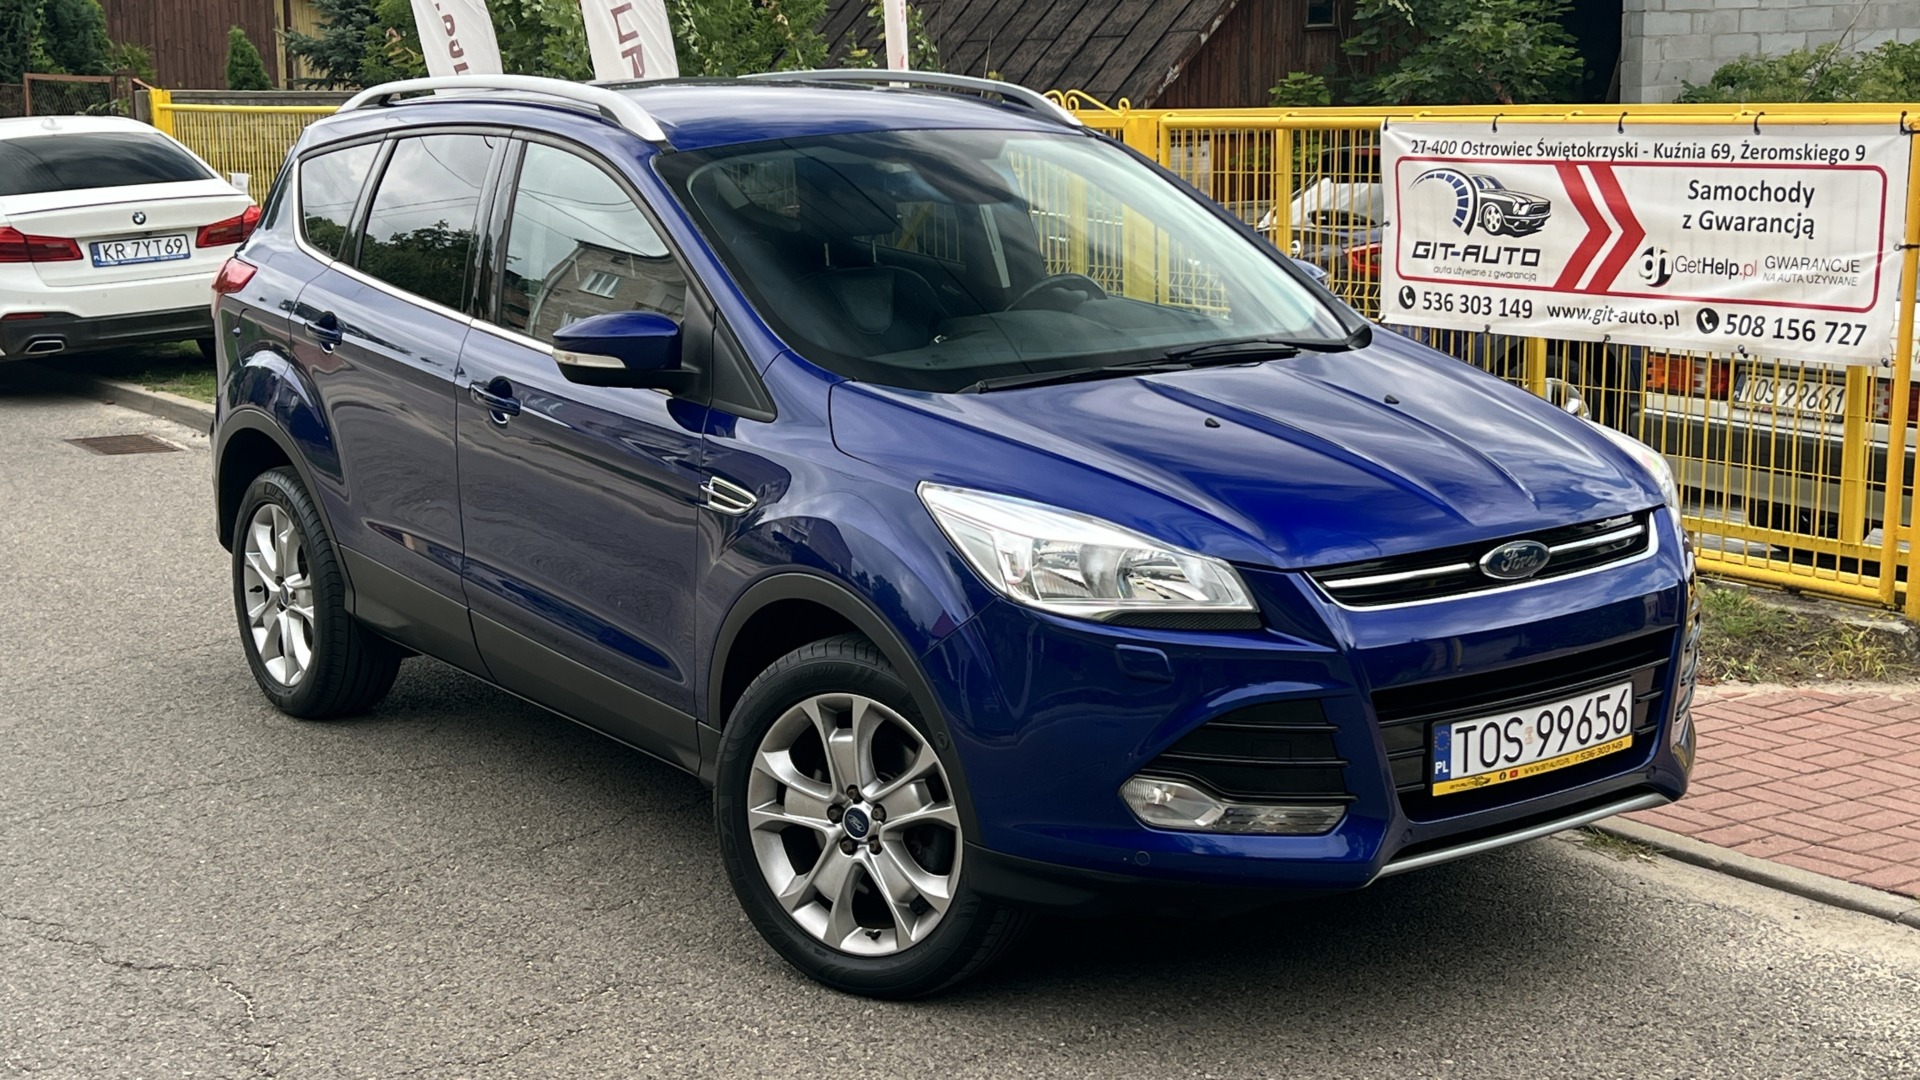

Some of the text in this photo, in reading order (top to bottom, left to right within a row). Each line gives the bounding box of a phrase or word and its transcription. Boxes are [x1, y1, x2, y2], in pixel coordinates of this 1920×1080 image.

[1411, 139, 1457, 155] 27-400
[1461, 140, 1533, 157] Ostrowiec
[1536, 138, 1638, 161] Świętokrzyski
[1653, 141, 1706, 159] Kuźnia
[1711, 143, 1736, 163] 69,
[1740, 140, 1850, 165] Żeromskiego
[1855, 144, 1866, 161] 9
[1688, 179, 1815, 208] Samochody
[1682, 210, 1815, 239] z Gwarancją
[103, 243, 126, 260] KR
[131, 238, 183, 258] 7YT69
[1412, 241, 1541, 267] GIT-AUTO
[1433, 265, 1452, 274] auta
[1453, 266, 1486, 278] używane
[1494, 270, 1536, 281] gwarancją
[1675, 255, 1757, 279] GetHelp.pl
[1765, 256, 1860, 273] GWARANCJE
[1762, 273, 1776, 282] NA
[1777, 273, 1805, 284] AUTA
[1422, 291, 1532, 319] 536 303 149
[1547, 304, 1680, 330] www.git-auto.pl
[1724, 314, 1867, 346] 508 156 727
[1501, 546, 1538, 572] Ford
[1455, 688, 1629, 774] TOS 99656
[1435, 761, 1449, 775] PL
